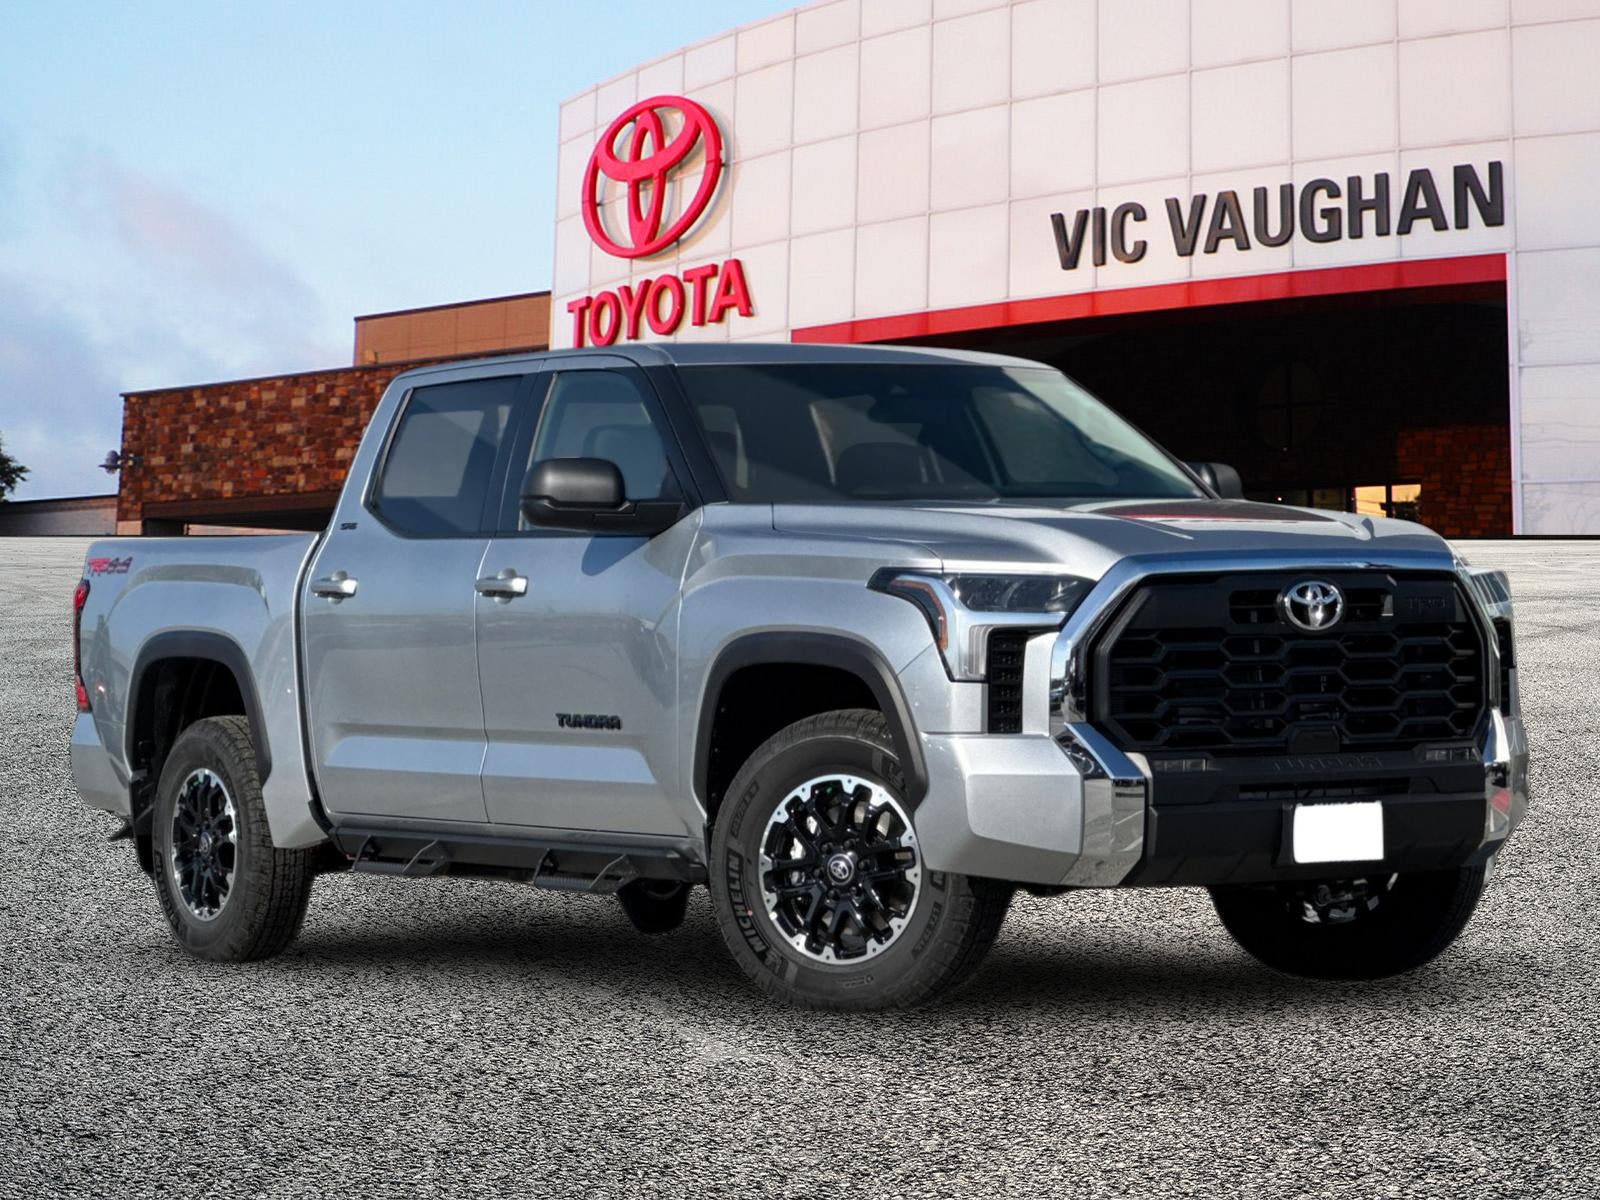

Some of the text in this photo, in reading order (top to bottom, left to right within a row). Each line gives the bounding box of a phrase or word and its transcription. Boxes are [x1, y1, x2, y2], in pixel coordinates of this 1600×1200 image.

[1050, 160, 1505, 271] VIC VAUGHAN
[567, 258, 755, 348] TOYOTA
[555, 713, 622, 730] TUNDRA
[727, 853, 767, 953] MICHELIN
